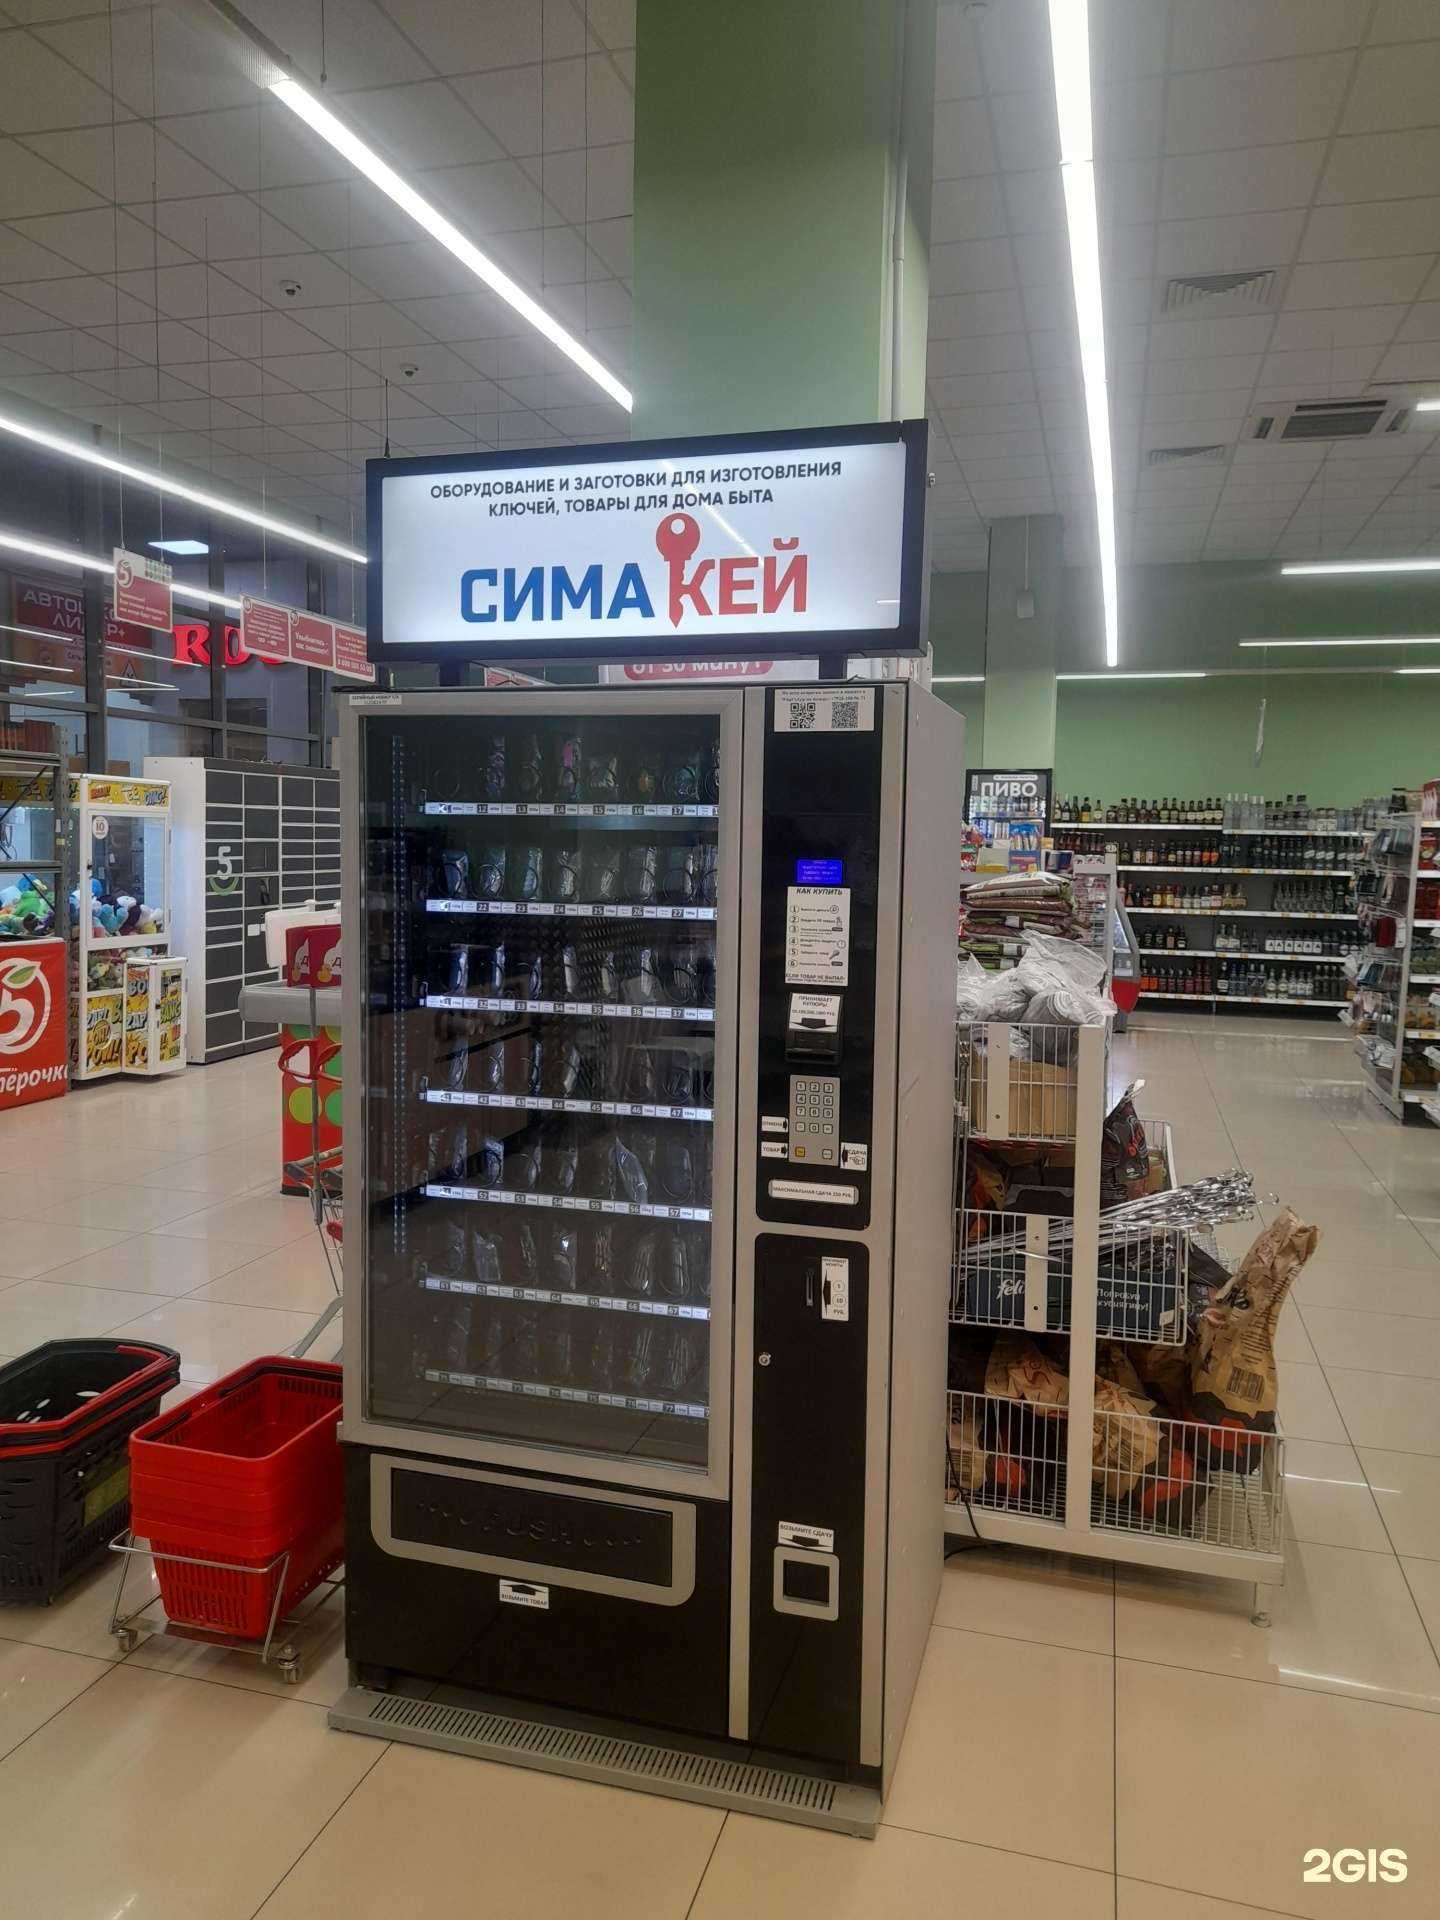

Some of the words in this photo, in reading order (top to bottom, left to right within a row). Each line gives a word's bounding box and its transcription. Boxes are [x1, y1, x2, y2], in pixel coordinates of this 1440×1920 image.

[430, 478, 555, 499] ОБОРУДОВАНИЕ
[559, 477, 570, 491] И
[573, 472, 667, 491] ЗАГОТОВКИ
[671, 467, 705, 486] ДЛЯ
[710, 461, 842, 483] ИЗГОТОВЛЕНИЯ
[488, 499, 560, 518] КЛЮЧЕЙ,
[565, 497, 630, 514] ТОВАРЫ
[634, 495, 669, 512] ДЛЯ
[672, 491, 724, 510] ДОМА
[728, 488, 774, 505] БЫТА
[981, 781, 1037, 797] ПИВО
[796, 887, 811, 895] КАК
[592, 1103, 601, 1111] 45
[632, 1106, 641, 1114] 46
[671, 1109, 681, 1117] 47
[996, 1278, 1025, 1300] feli
